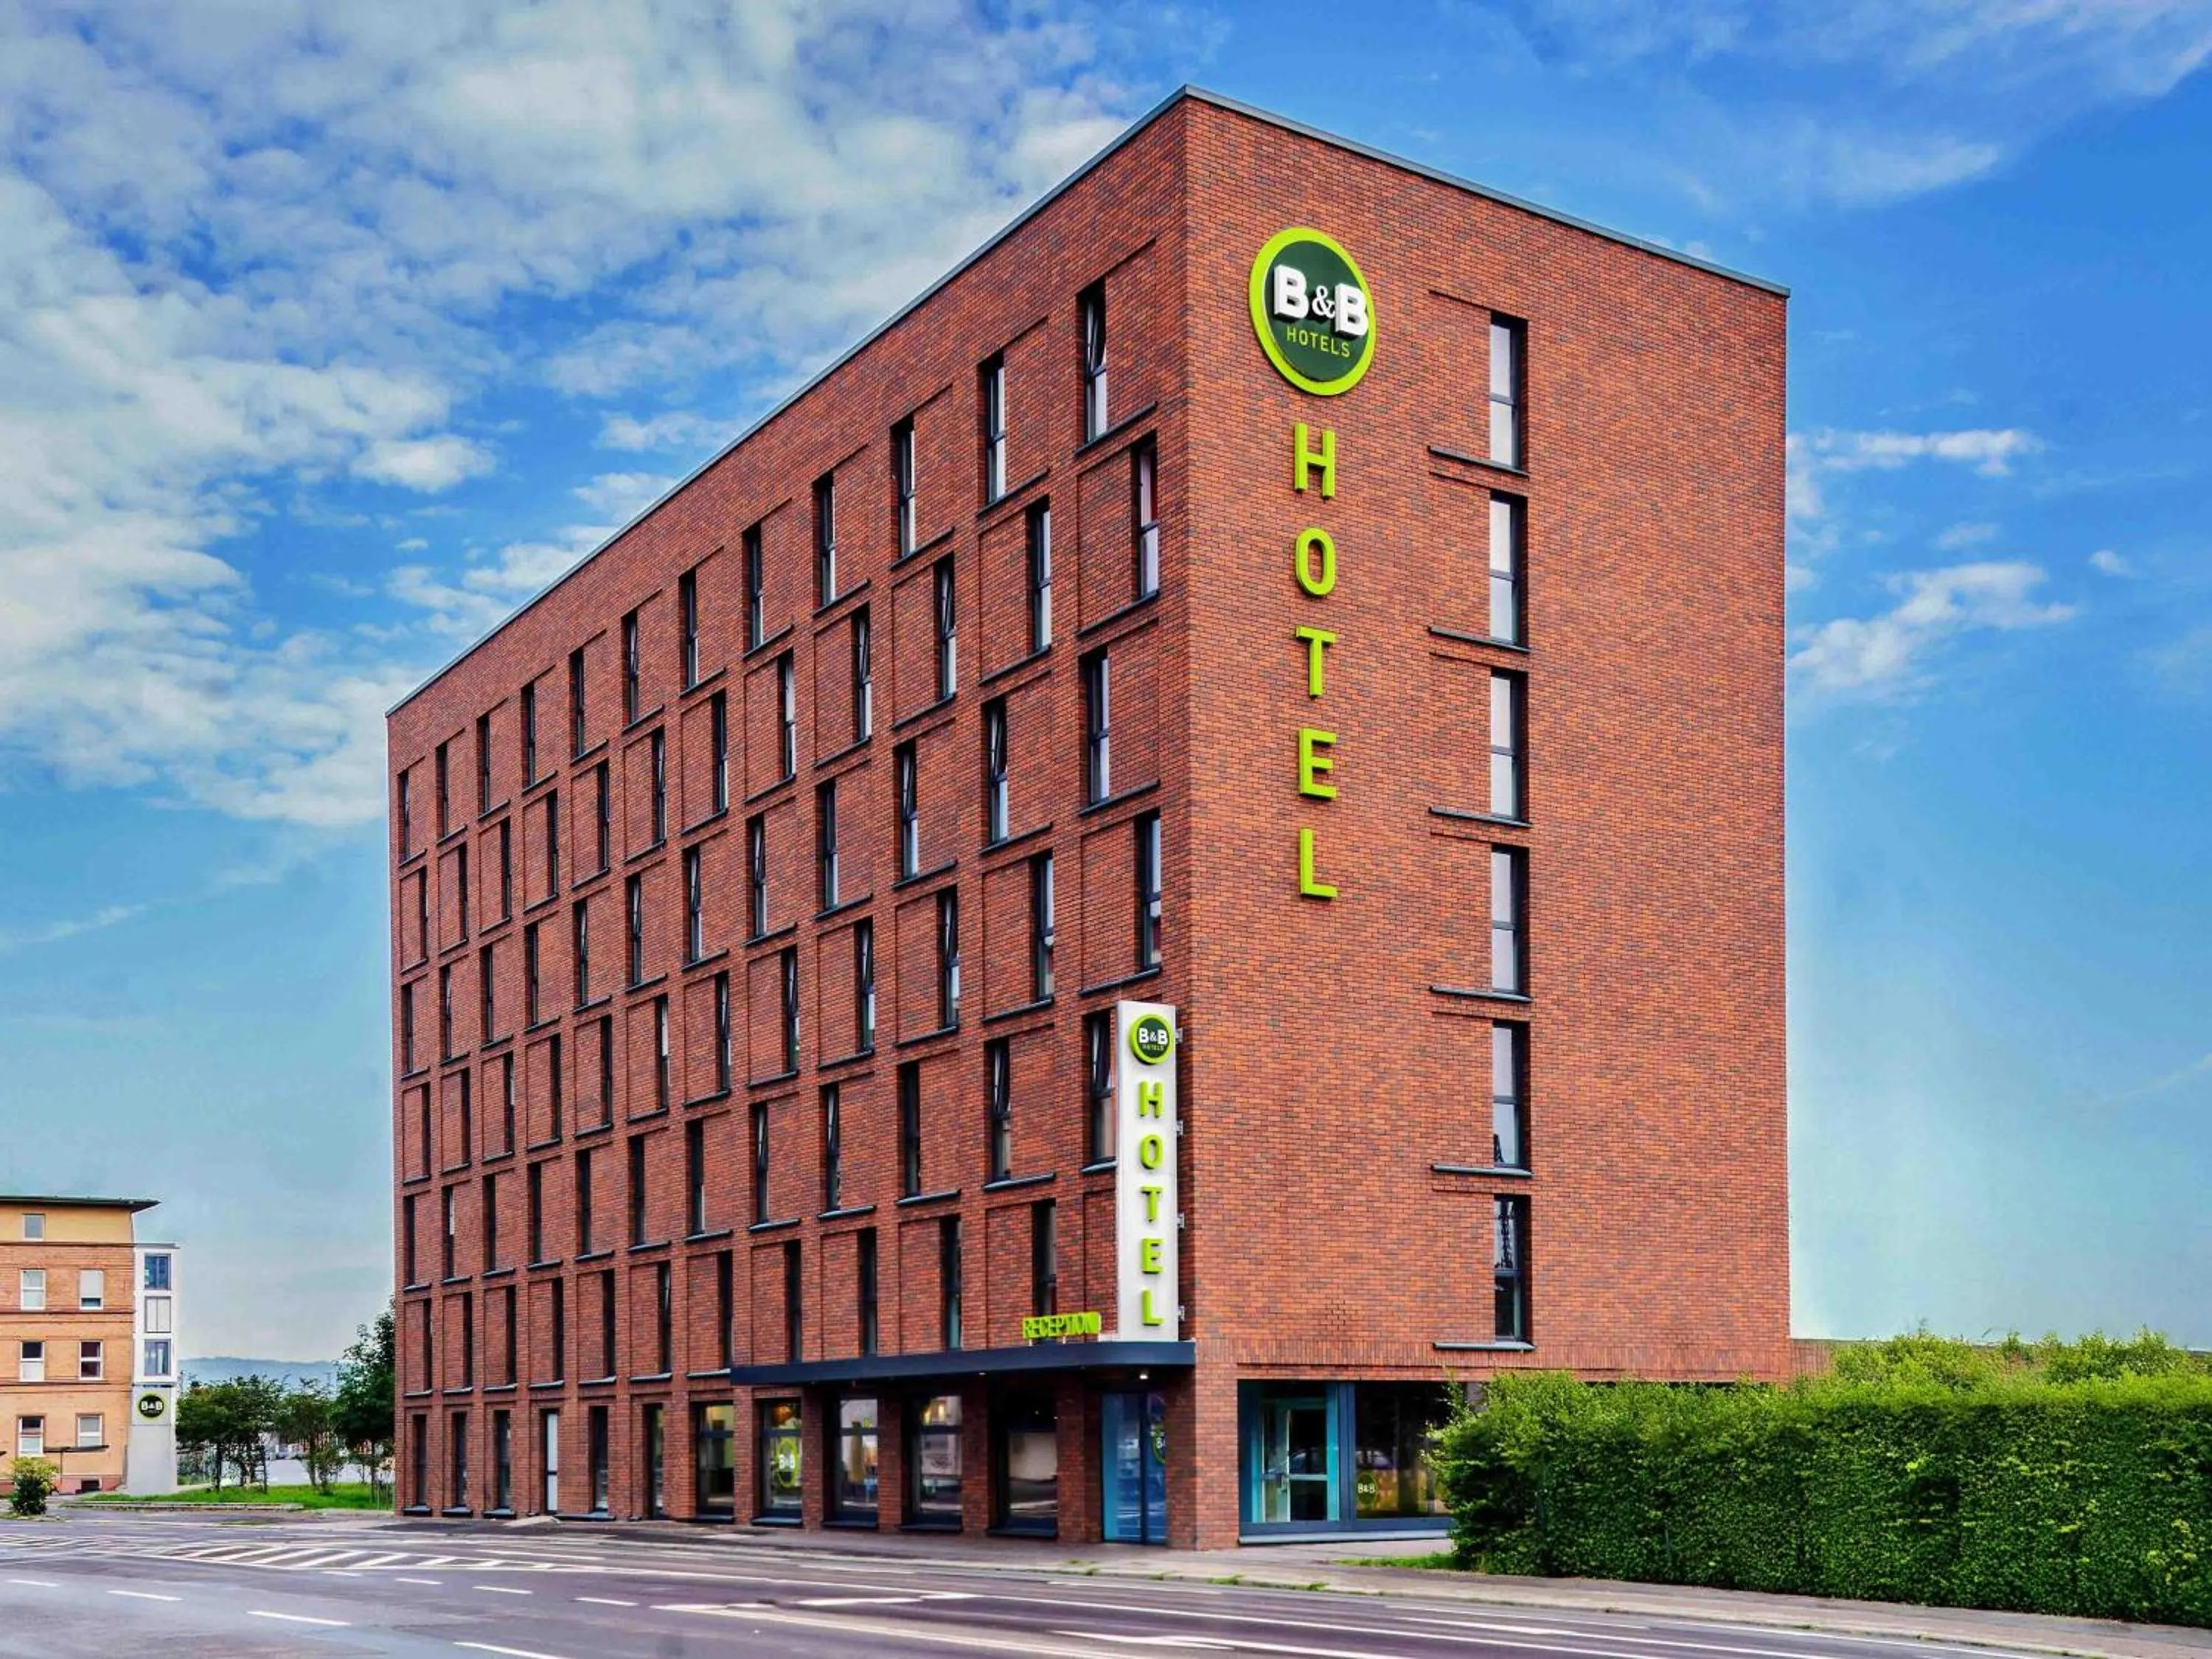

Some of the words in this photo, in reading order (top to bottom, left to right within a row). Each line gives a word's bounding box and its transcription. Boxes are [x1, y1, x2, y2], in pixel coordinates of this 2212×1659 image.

[1274, 264, 1369, 336] B&B
[1287, 326, 1351, 358] HOTELS
[1294, 422, 1338, 898] HOTEL
[1138, 1027, 1169, 1045] B&B
[1139, 1081, 1165, 1326] HOTEL
[1357, 1483, 1375, 1494] B&B
